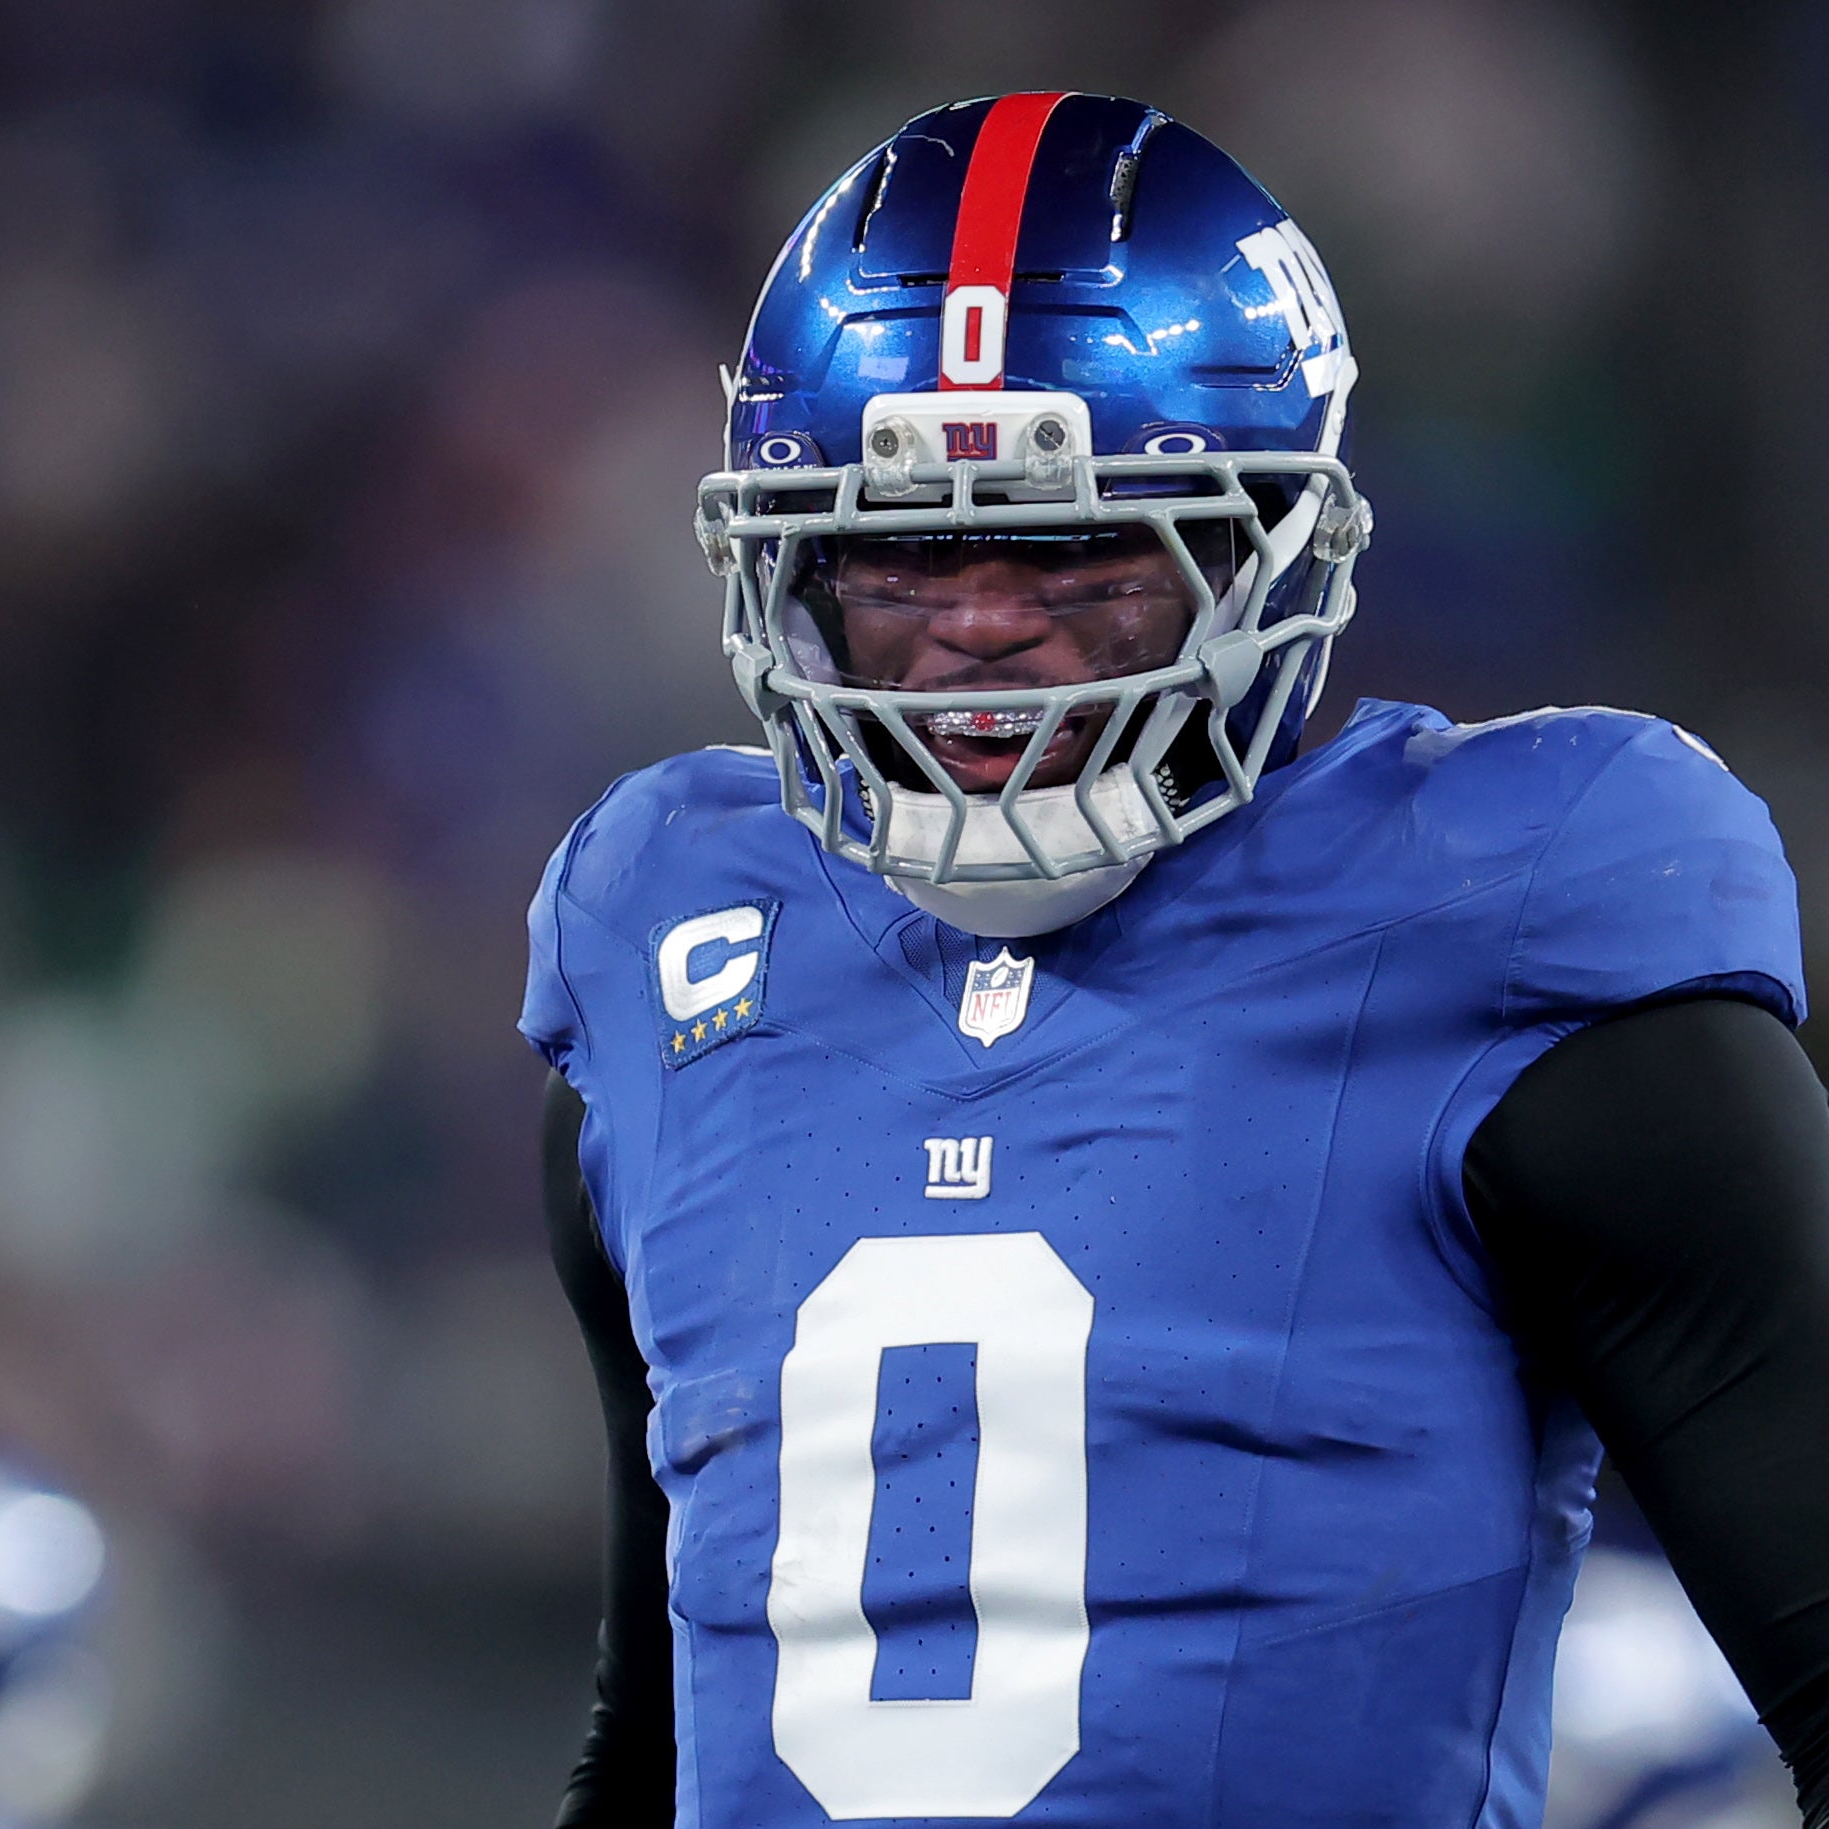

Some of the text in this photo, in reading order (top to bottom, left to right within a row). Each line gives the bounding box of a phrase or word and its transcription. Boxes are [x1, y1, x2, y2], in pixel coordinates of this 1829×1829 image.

[941, 285, 1007, 385] 0
[658, 904, 763, 1021] C
[923, 1134, 994, 1200] ny
[767, 1231, 1096, 1821] 0
